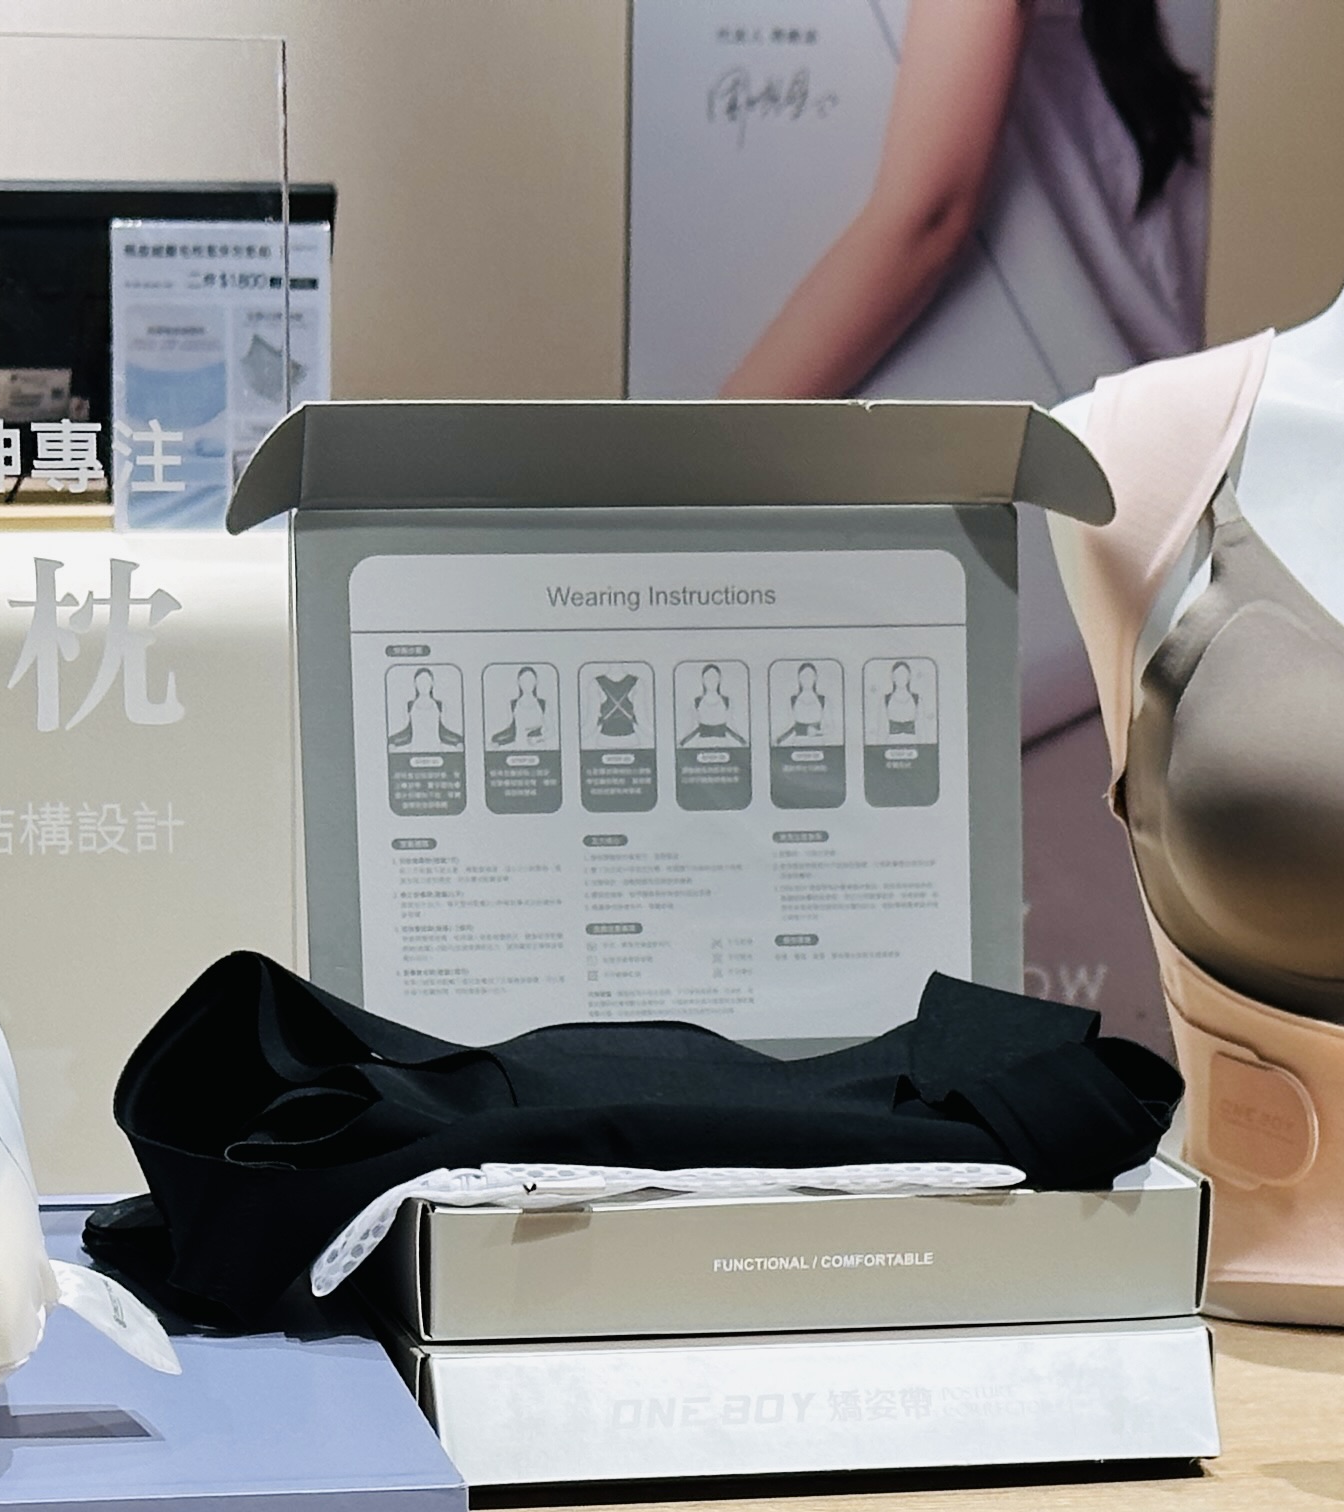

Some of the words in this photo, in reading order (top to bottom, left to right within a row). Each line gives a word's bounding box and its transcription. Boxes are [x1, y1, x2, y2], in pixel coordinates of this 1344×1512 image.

[546, 585, 641, 612] Wearing
[648, 583, 777, 606] Instructions
[713, 1257, 810, 1273] FUNCTIONAL
[811, 1256, 819, 1270] /
[820, 1251, 935, 1270] COMFORTABLE
[611, 1394, 714, 1430] ONE
[718, 1391, 819, 1426] BOY
